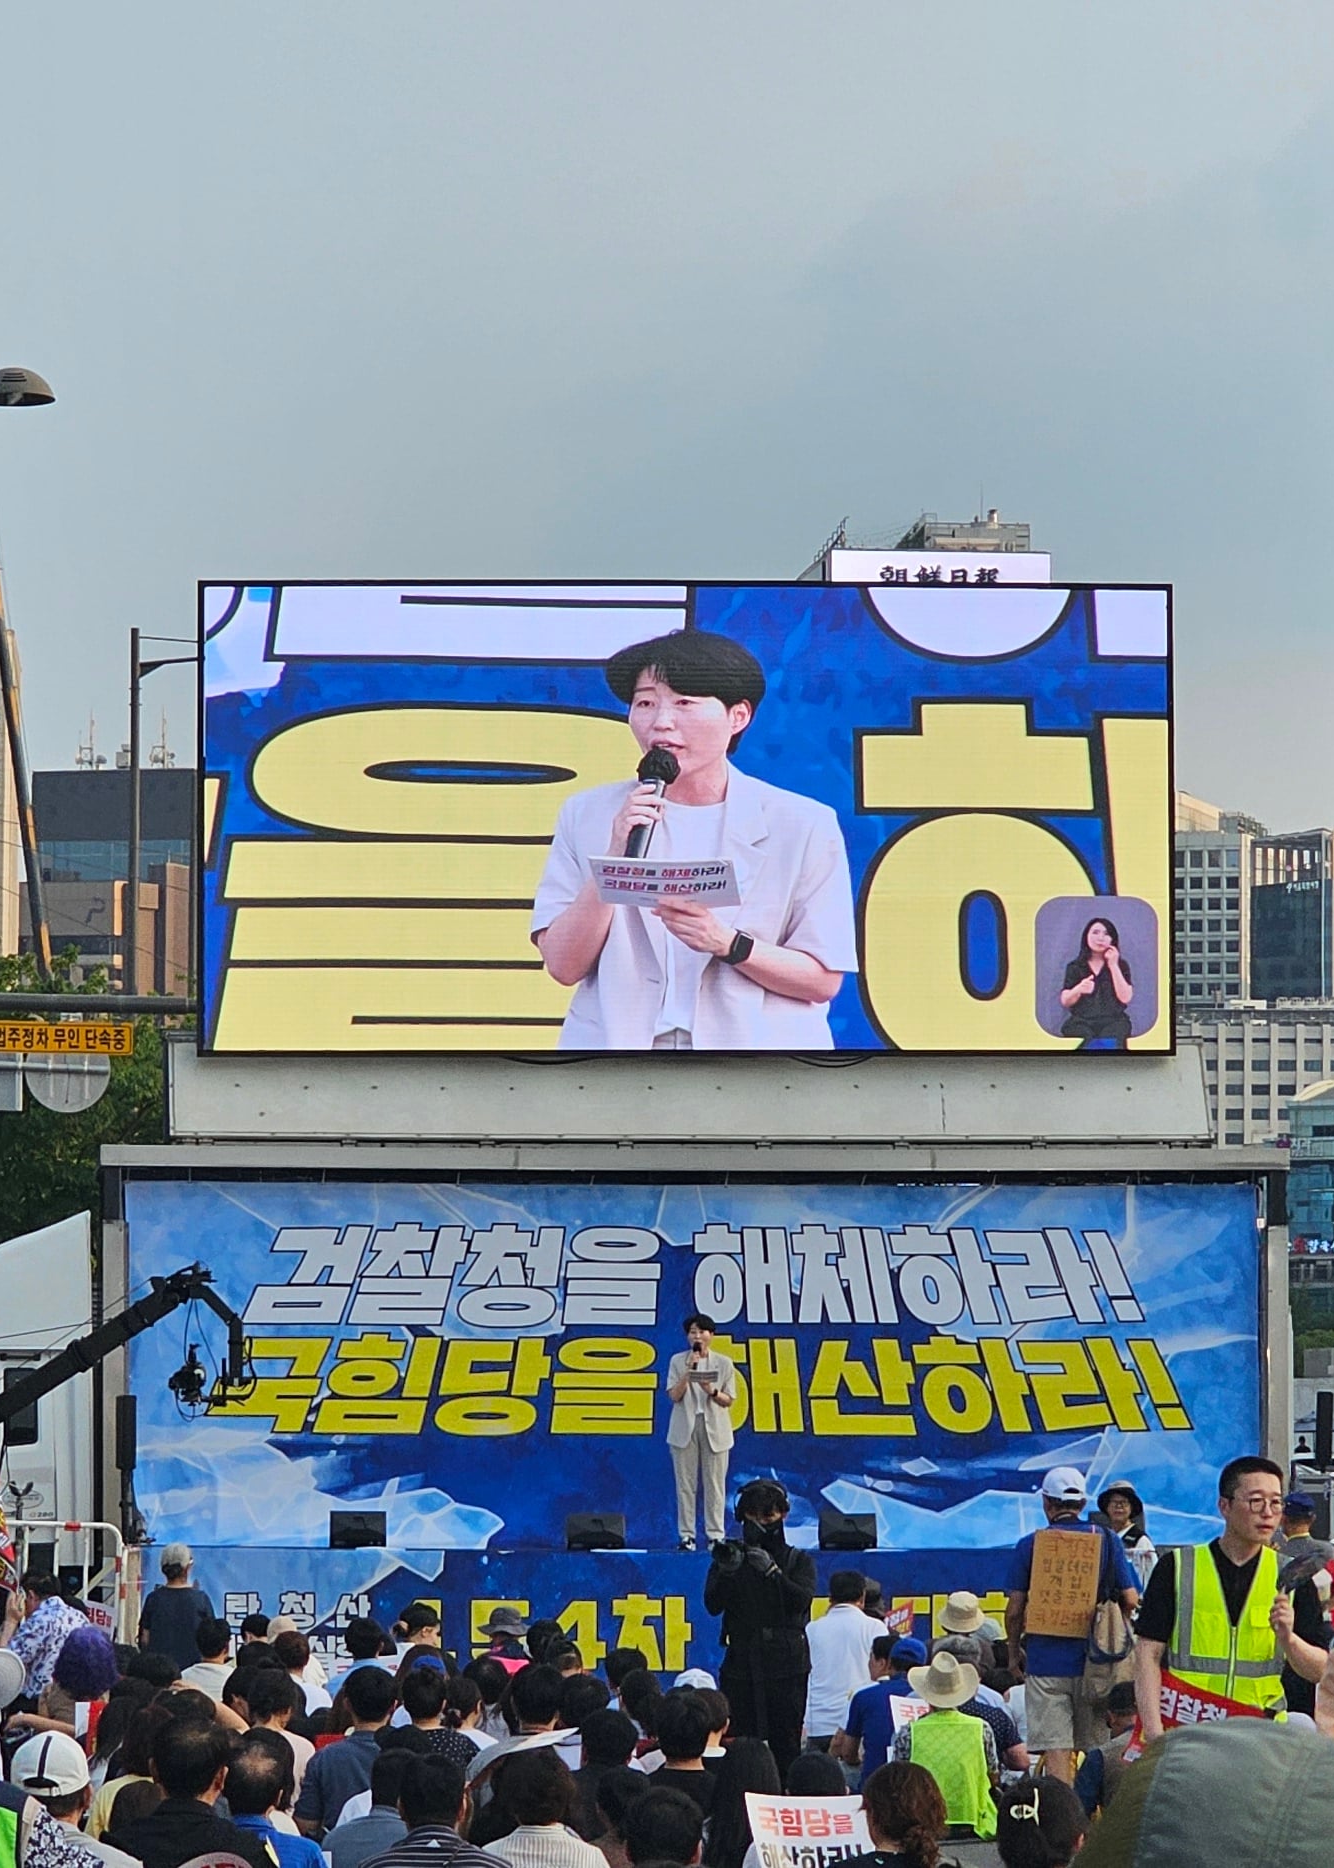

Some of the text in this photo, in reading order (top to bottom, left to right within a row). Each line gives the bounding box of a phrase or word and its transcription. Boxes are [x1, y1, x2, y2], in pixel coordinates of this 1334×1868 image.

[53, 1029, 80, 1050] 무인
[85, 1027, 127, 1051] 단속중
[243, 1221, 1147, 1327] 검찰청을 해체하라!
[207, 1332, 1195, 1437] 국힘당을 해산하라!
[757, 1806, 854, 1837] 국힘당을
